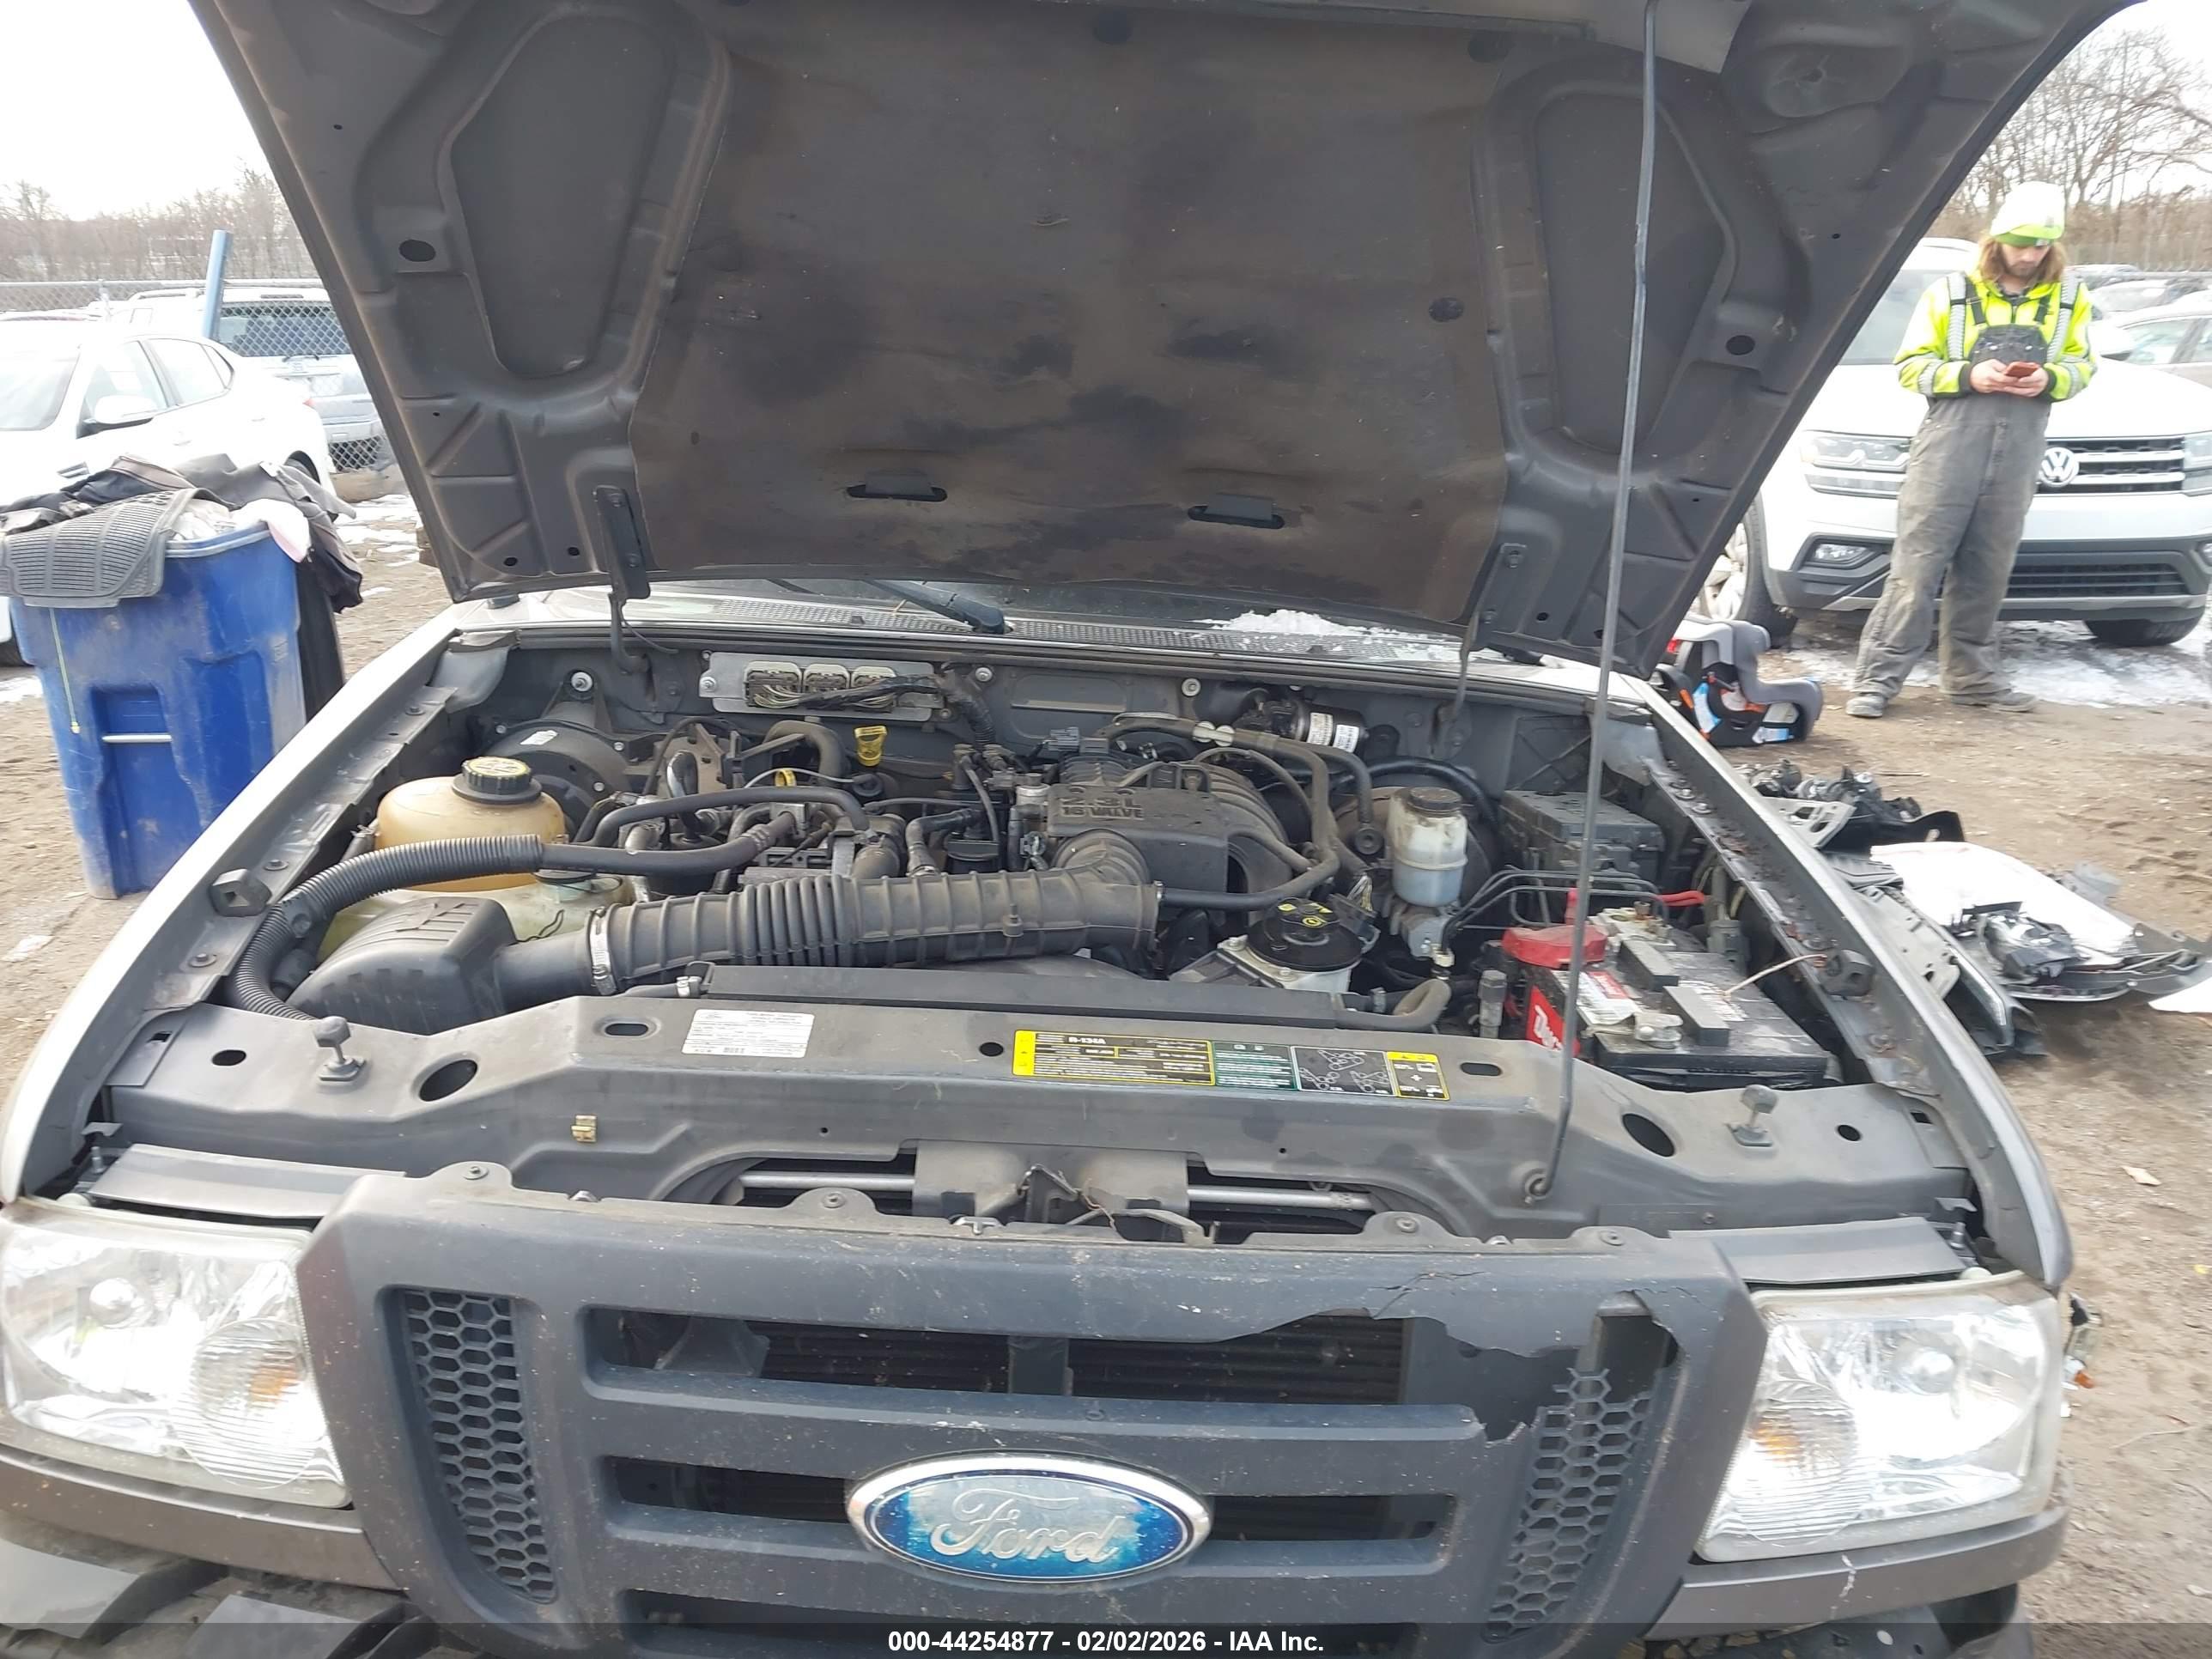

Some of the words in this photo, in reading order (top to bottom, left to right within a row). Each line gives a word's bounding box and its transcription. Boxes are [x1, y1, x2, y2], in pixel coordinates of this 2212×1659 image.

[1061, 806, 1085, 817] 16
[1087, 806, 1145, 821] VALVE
[930, 1488, 1120, 1564] Ford
